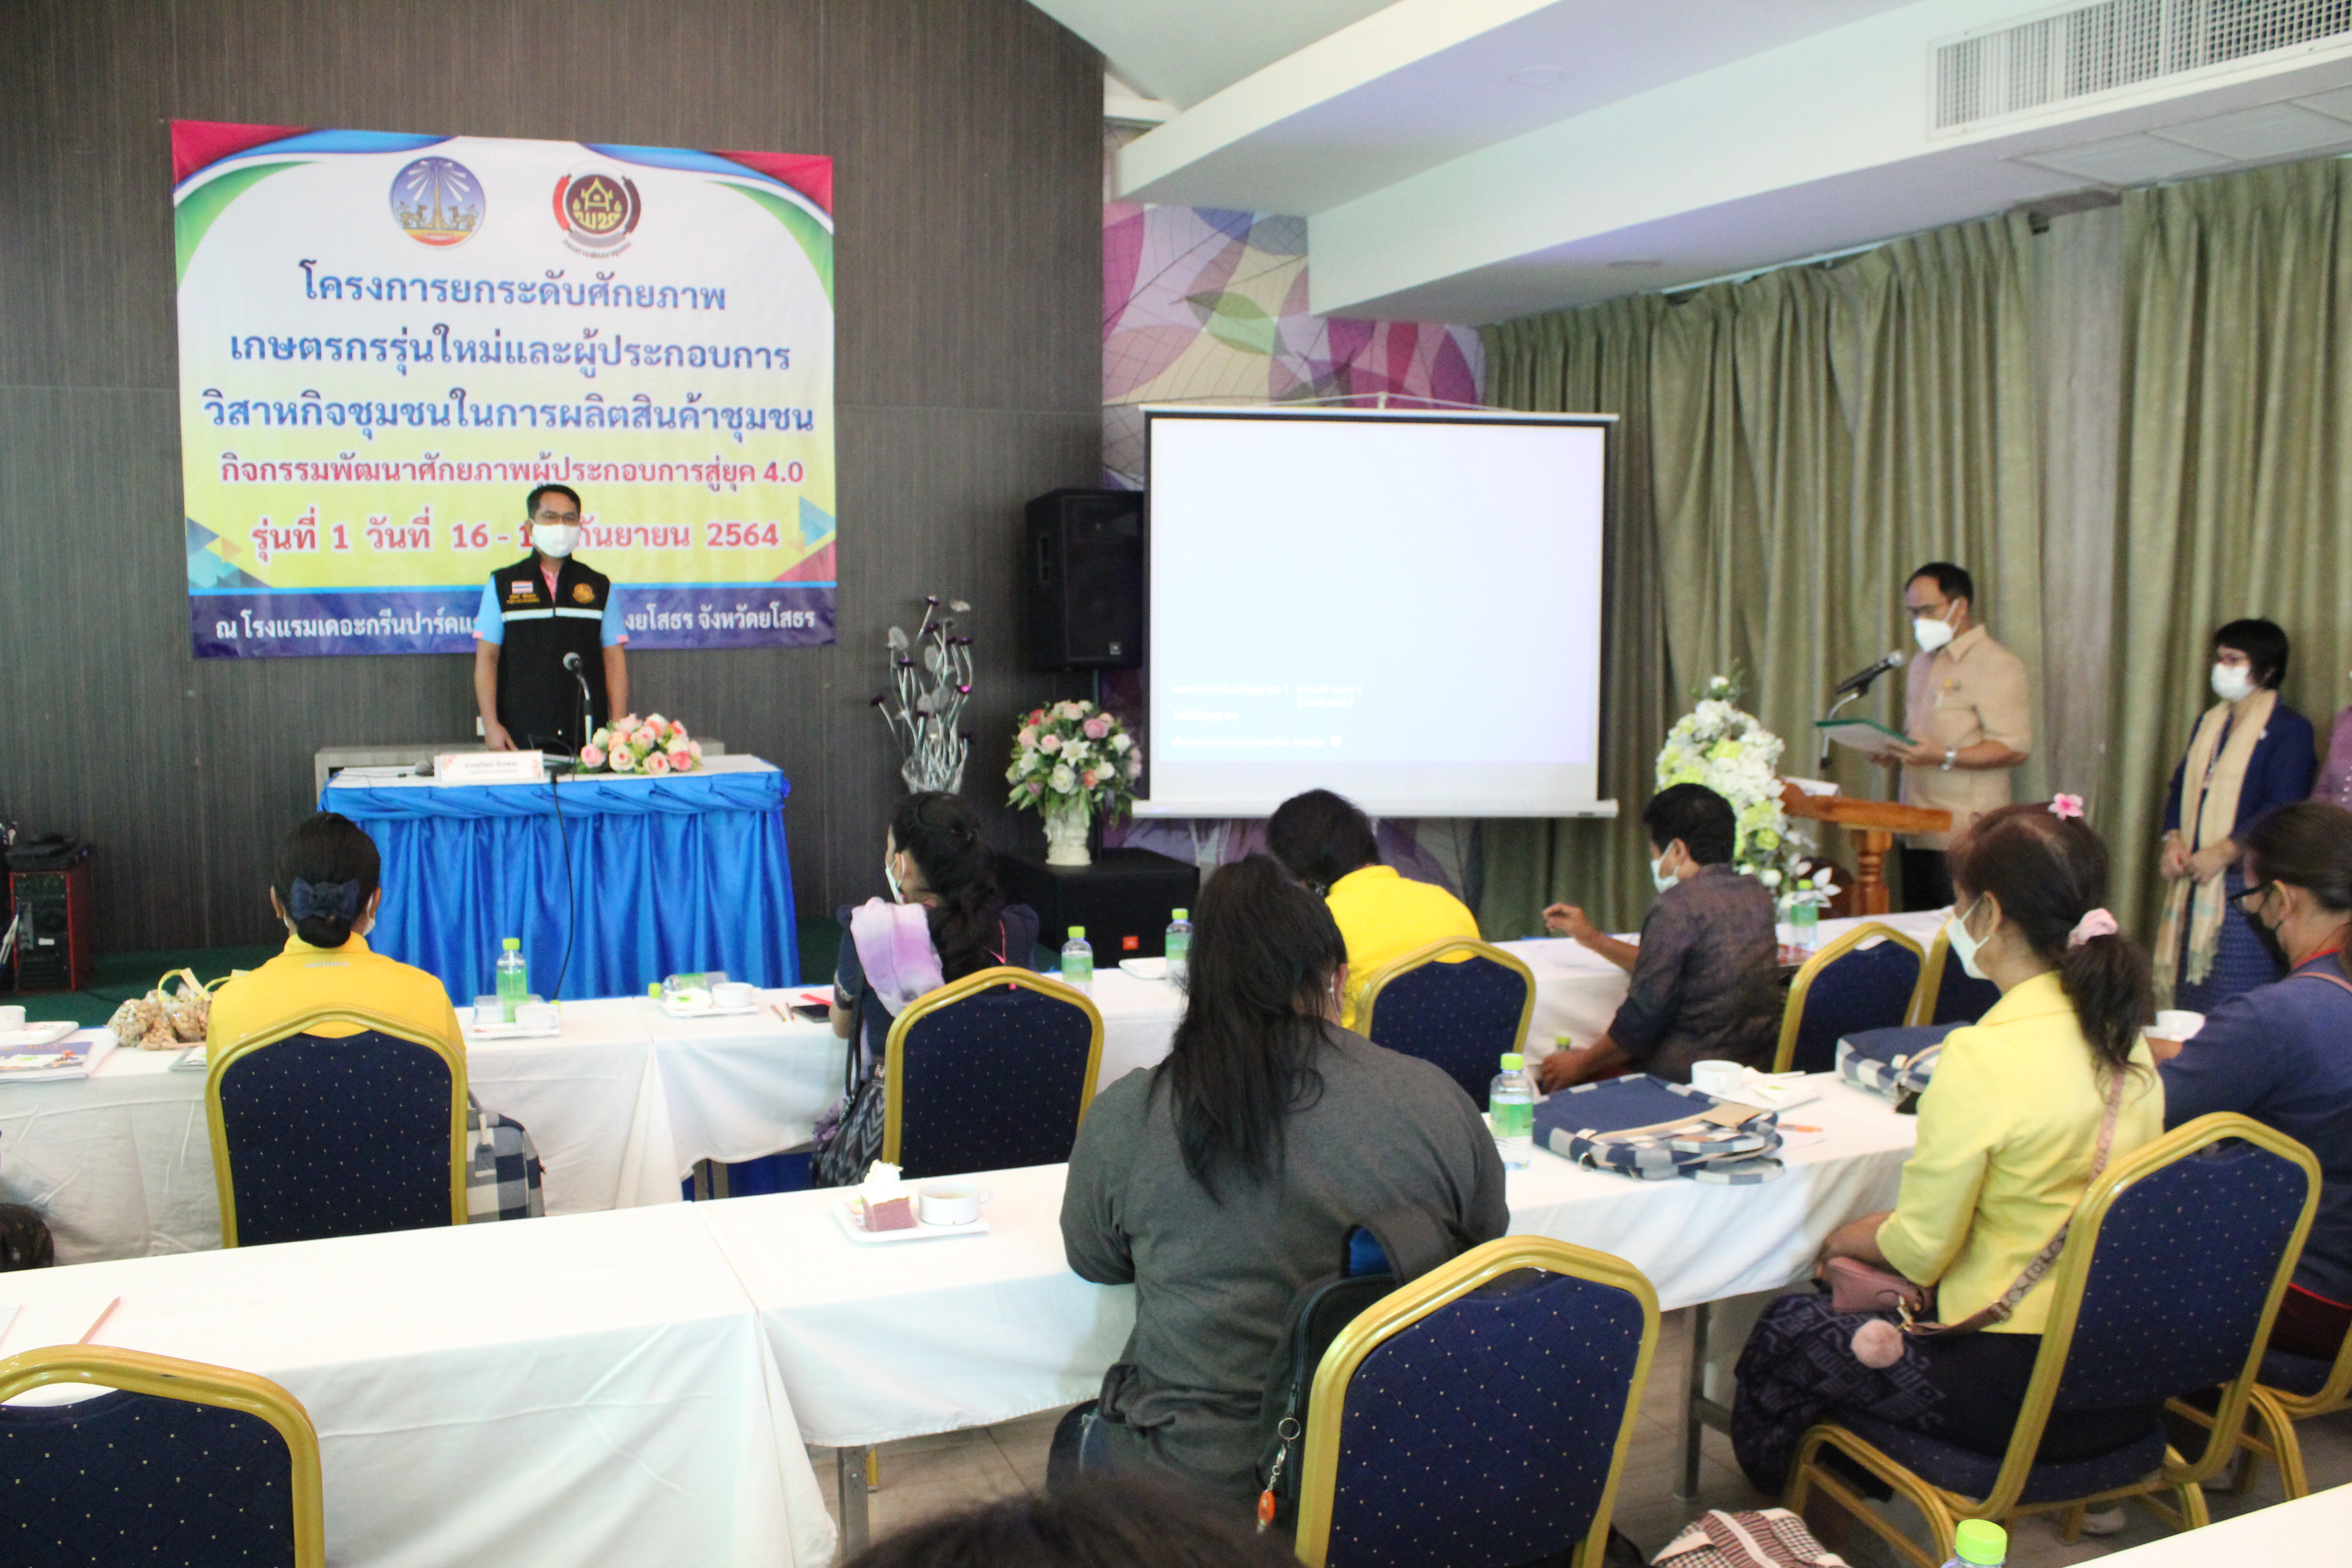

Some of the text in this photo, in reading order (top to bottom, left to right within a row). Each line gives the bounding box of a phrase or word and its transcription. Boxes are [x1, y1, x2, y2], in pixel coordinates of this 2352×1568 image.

[298, 259, 726, 310] โครงการยกระดับศักยภาพ
[230, 323, 790, 378] เกษตรกรรุ่นใหม่และผู้ประกอบการ
[202, 387, 814, 443] วิสาหกิจชุมชนในการผลิตสินค้าชุมชน
[763, 461, 804, 483] 4.0
[252, 506, 316, 563] รุ่นที่
[333, 524, 348, 549] 1
[366, 506, 430, 549] วันที่
[452, 523, 489, 548] 16
[706, 523, 779, 547] 2564
[216, 602, 816, 639] ณ โรงแรมเดอะกรีนปาร์คแ งยโสธร จังหวัดยโสธร
